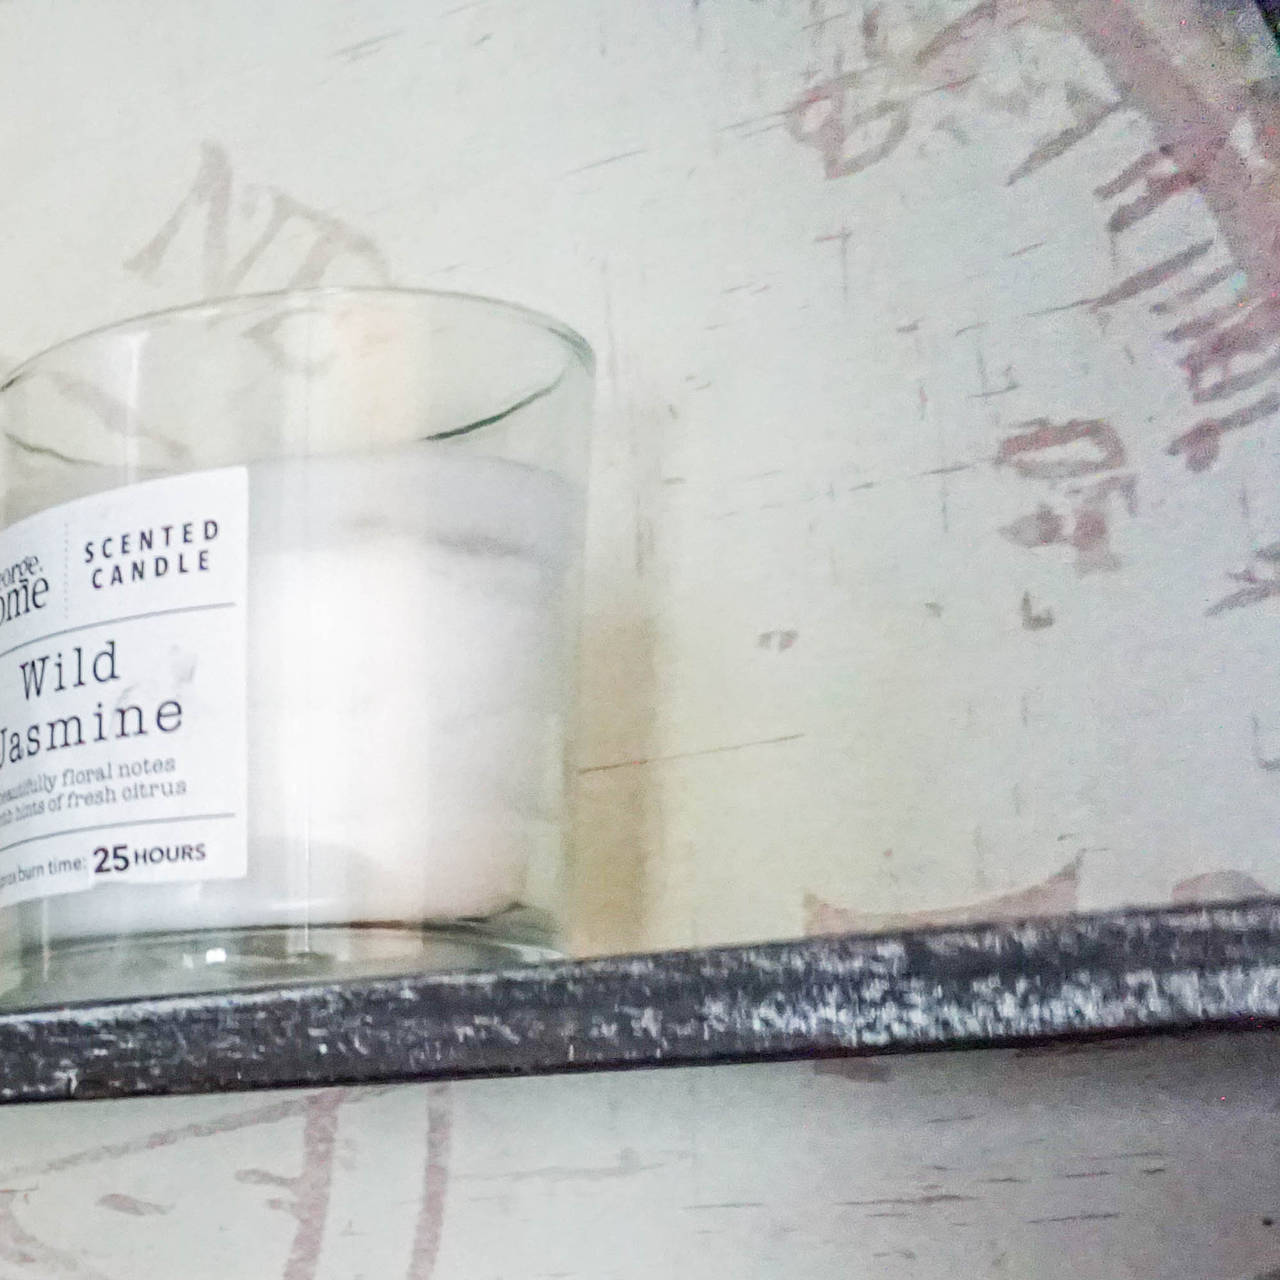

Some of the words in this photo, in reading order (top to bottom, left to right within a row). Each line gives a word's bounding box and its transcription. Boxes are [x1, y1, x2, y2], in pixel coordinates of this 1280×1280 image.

[84, 519, 219, 564] SCENTED
[92, 548, 210, 589] CANDLE
[19, 640, 121, 701] Wild
[62, 762, 114, 788] floral
[119, 756, 176, 779] notes
[47, 794, 66, 813] of
[65, 784, 117, 809] fresh
[121, 778, 188, 801] citrus
[93, 844, 130, 873] 25
[133, 843, 207, 866] HOURS
